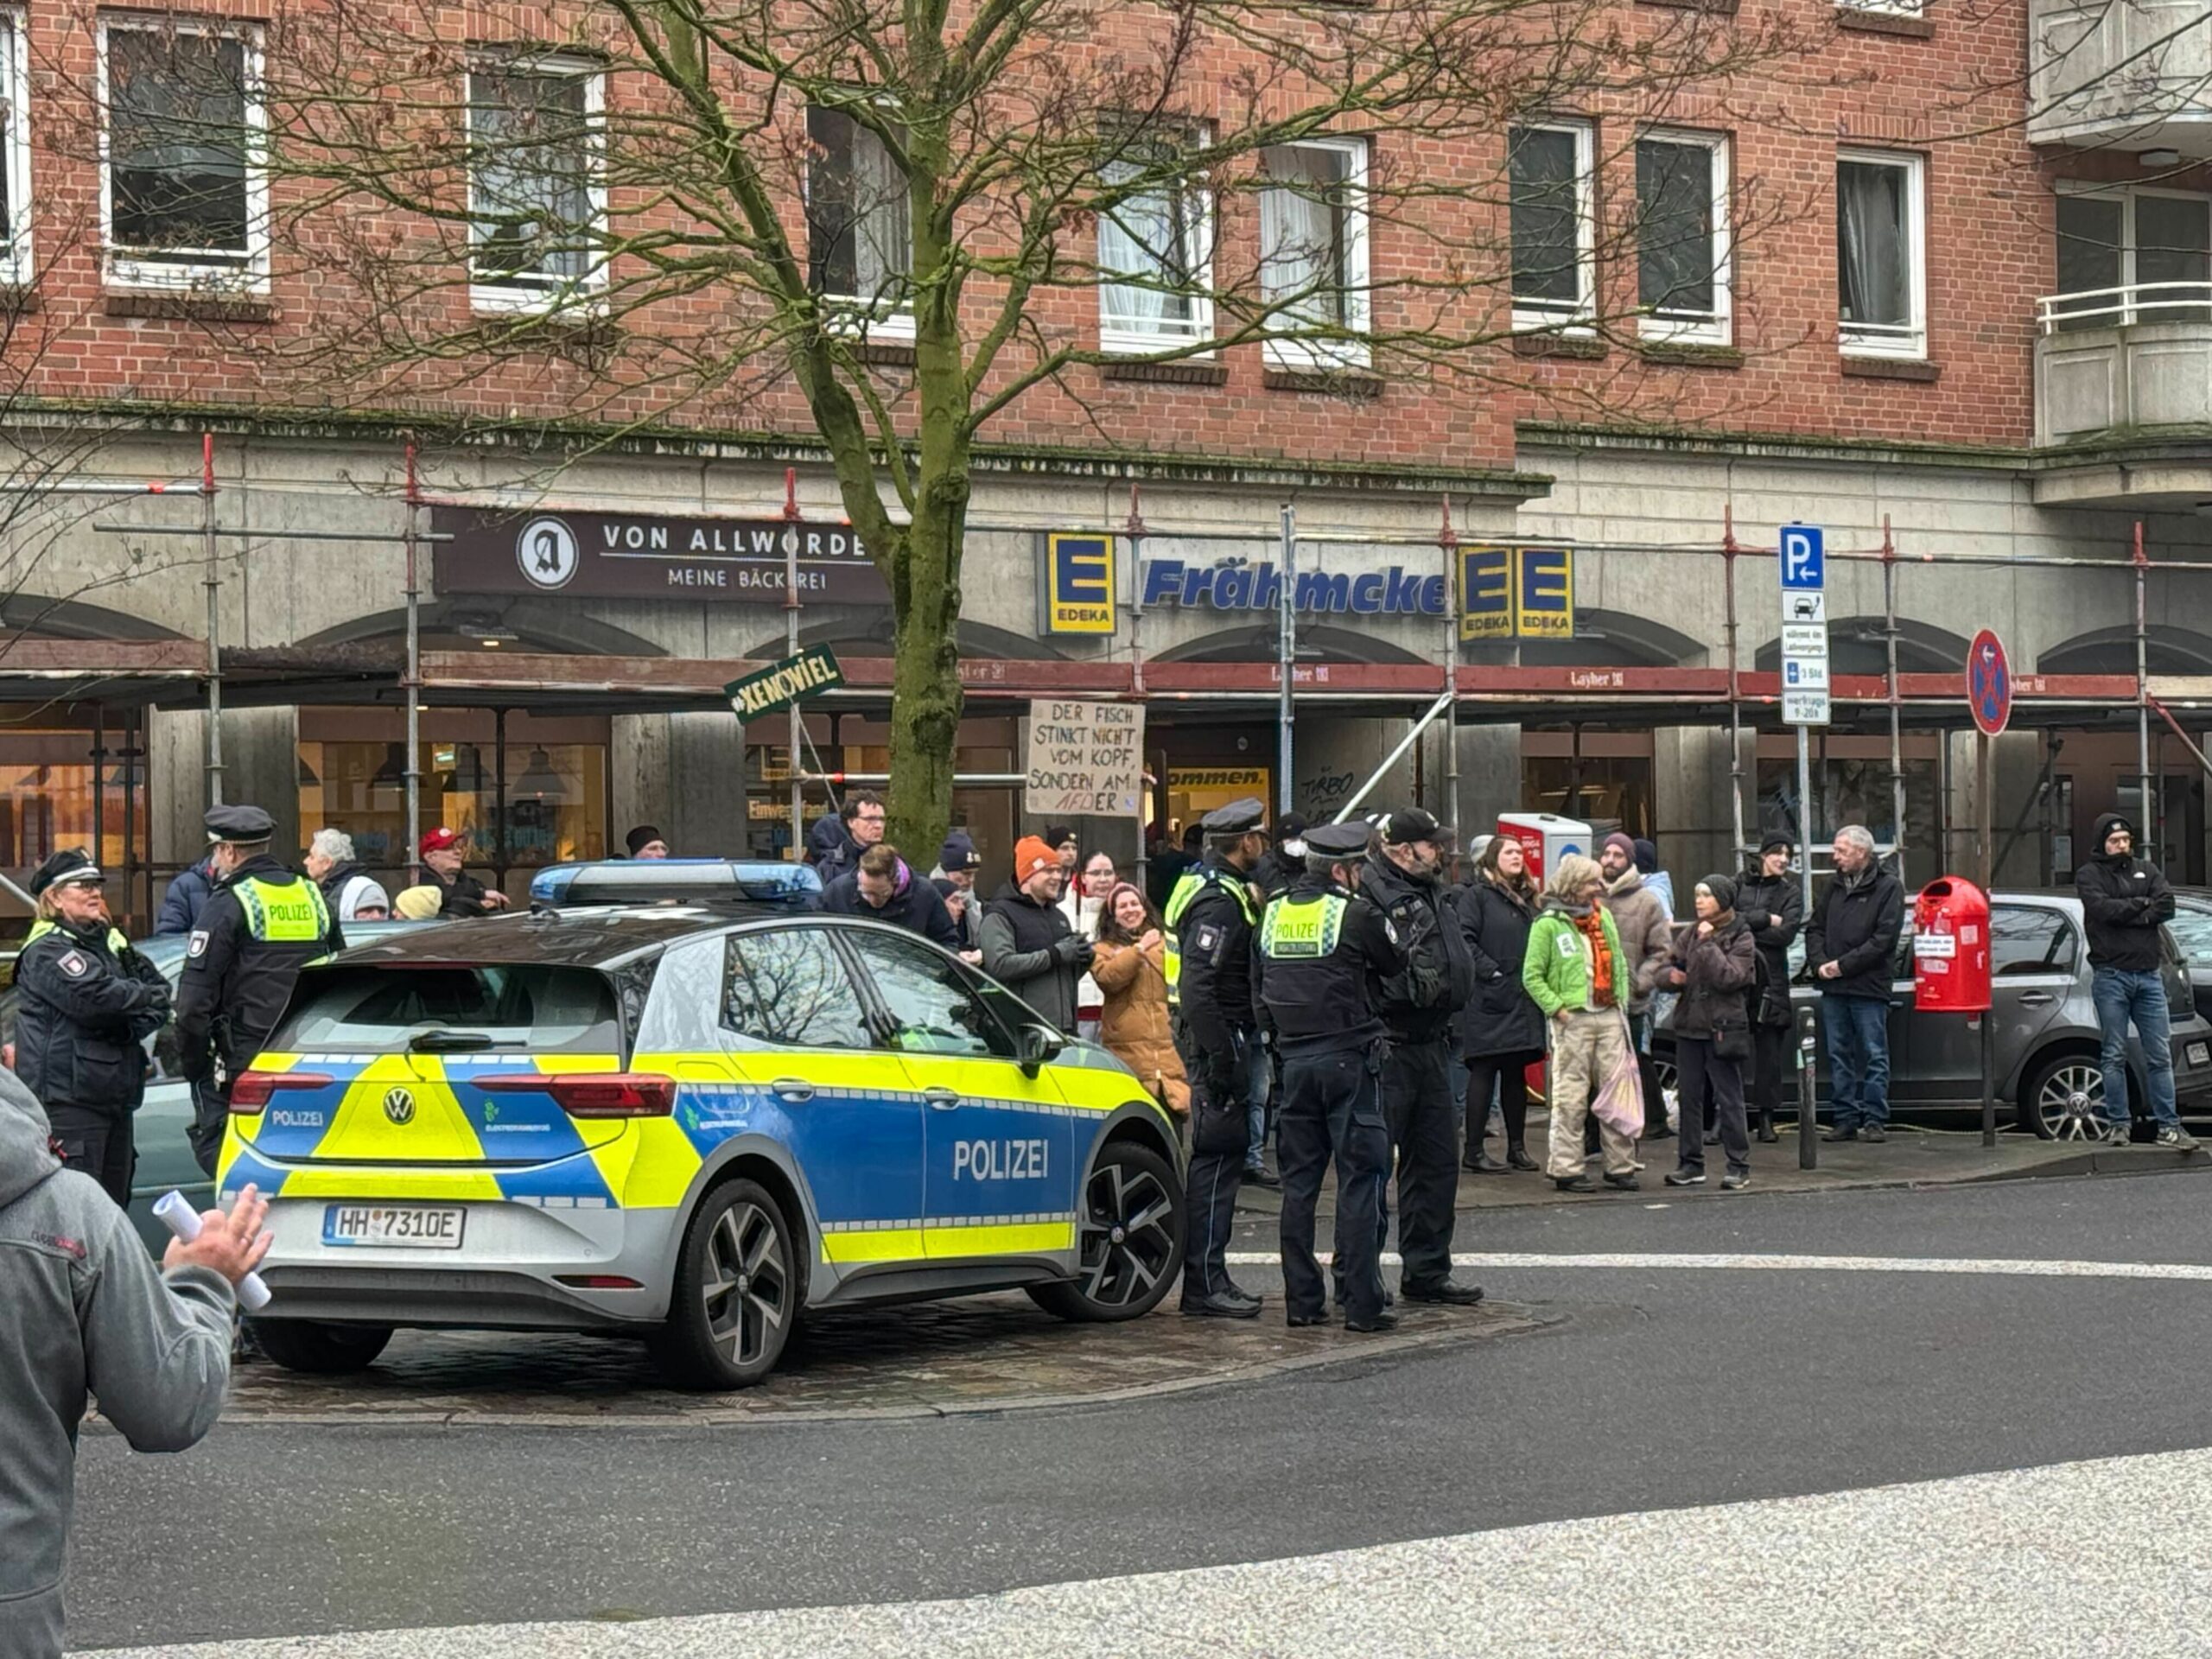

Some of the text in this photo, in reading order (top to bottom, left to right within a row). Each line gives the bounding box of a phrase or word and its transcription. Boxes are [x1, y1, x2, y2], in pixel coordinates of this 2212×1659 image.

[603, 525, 668, 550] VON
[1786, 534, 1812, 582] P
[668, 569, 826, 589] MEINE BÄCKREI
[1056, 539, 1108, 603] E
[1143, 556, 1447, 614] Frähmcke
[1057, 608, 1109, 621] EDEKA
[1465, 616, 1510, 631] EDEKA
[1522, 616, 1569, 629] EDEKA
[1570, 671, 1610, 689] Layher
[1052, 703, 1134, 723] DER FISCH
[1034, 724, 1136, 746] STINKT NICHT
[1050, 747, 1135, 770] VOM KOPF,
[1029, 768, 1130, 791] SONDERN AM
[269, 903, 314, 921] POLIZEI
[1275, 923, 1319, 939] POLIZEI
[272, 1110, 323, 1127] POLIZEI
[954, 1139, 1049, 1181] POLIZEI
[339, 1210, 456, 1237] HH 7310E
